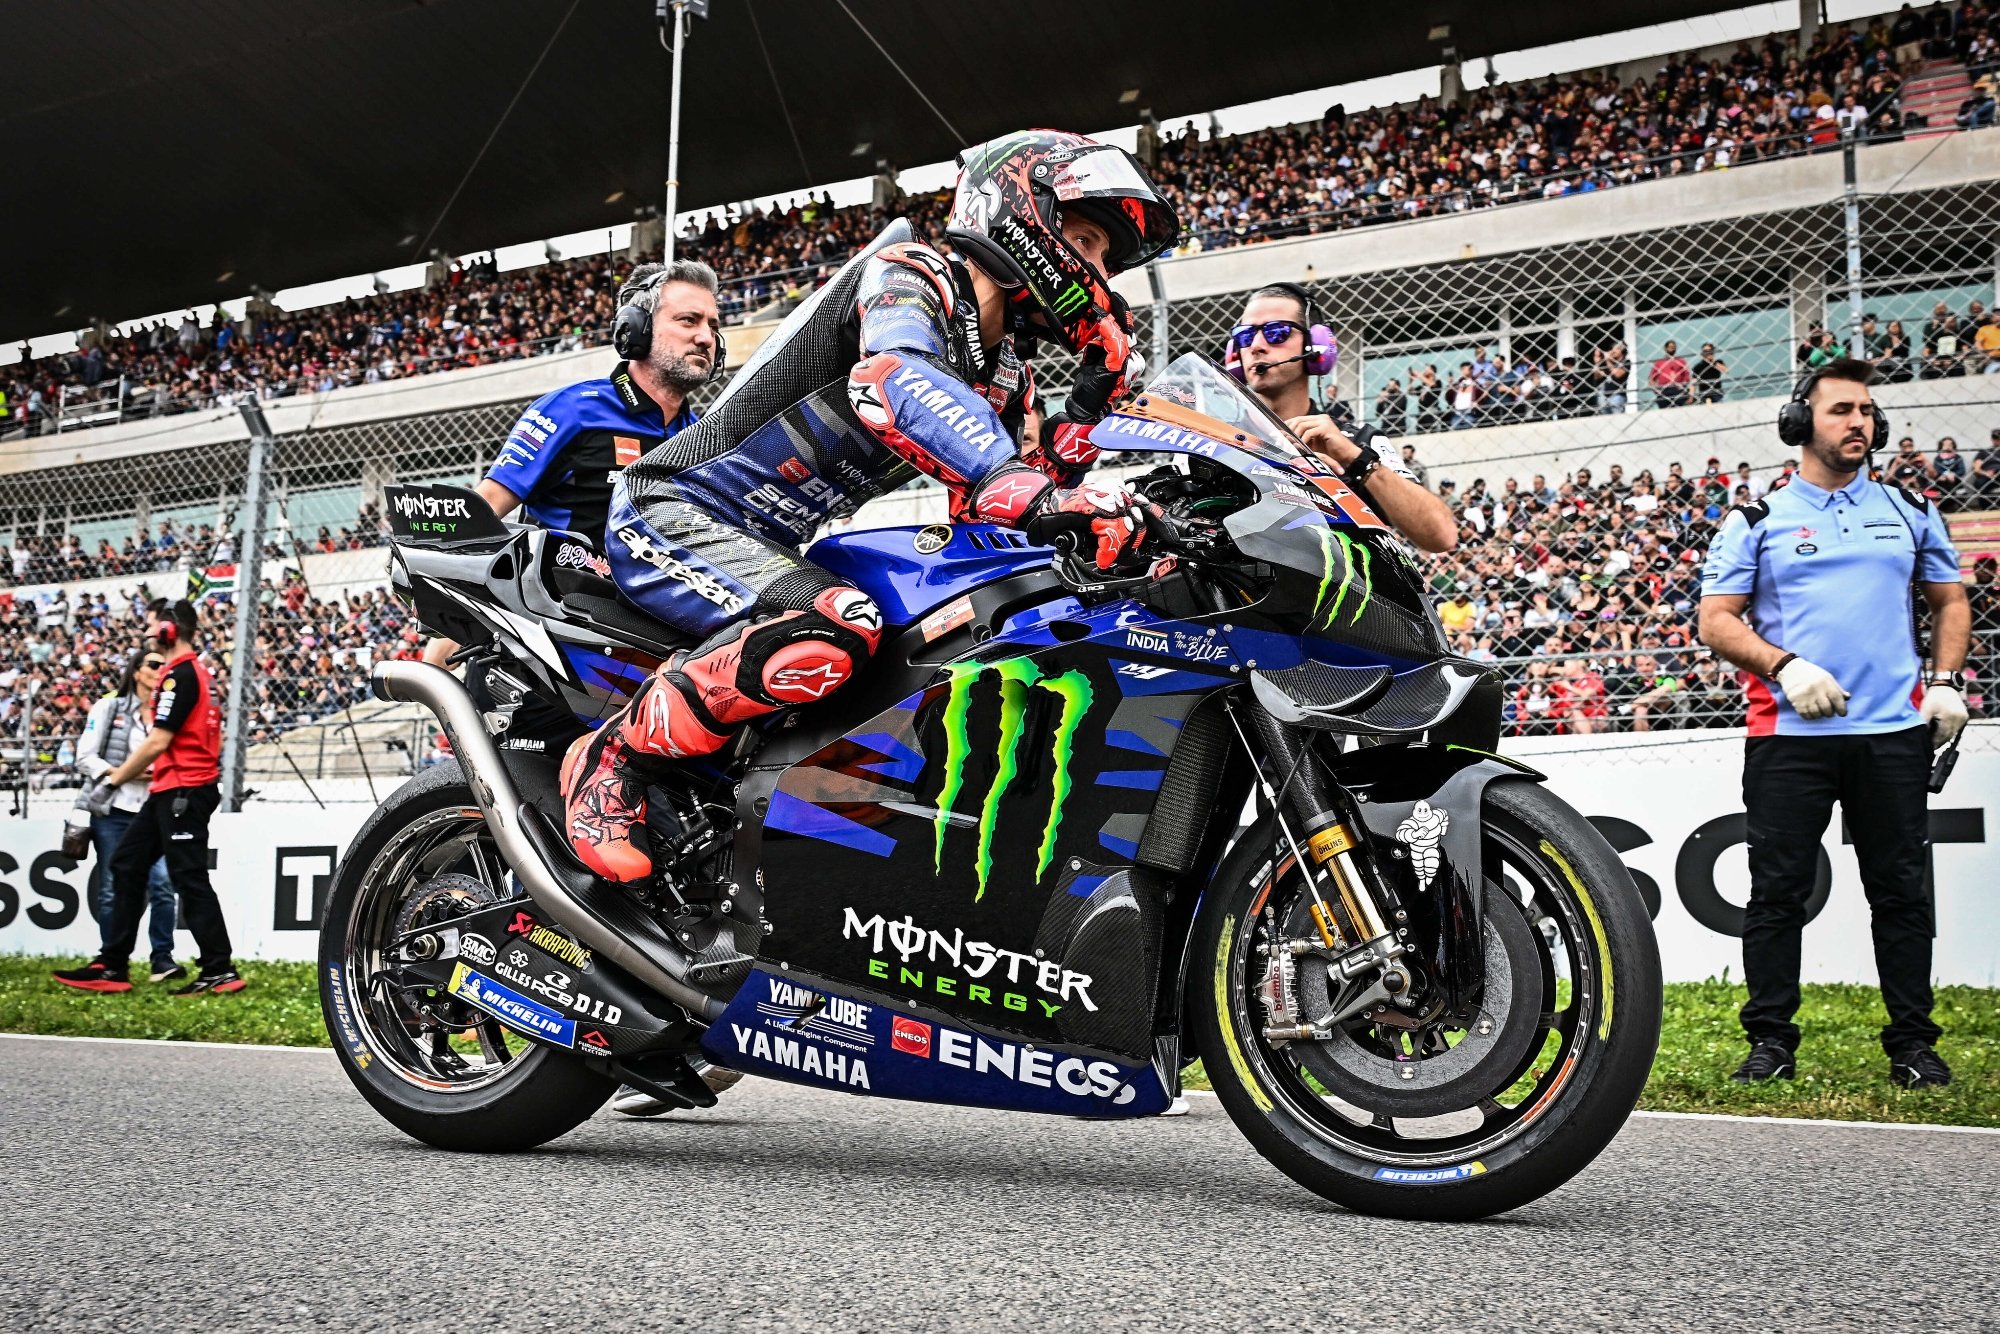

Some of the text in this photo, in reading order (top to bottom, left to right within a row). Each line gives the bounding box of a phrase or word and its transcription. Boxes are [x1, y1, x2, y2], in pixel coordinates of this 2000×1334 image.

[1002, 216, 1062, 289] MONSTER
[1003, 238, 1043, 285] ENERGY
[965, 311, 986, 371] YAMAHA
[893, 366, 1000, 453] YAMAHA
[1106, 415, 1220, 458] YAMAHA
[393, 493, 471, 519] MONSTER
[1273, 481, 1335, 510] YAMALUBE
[618, 527, 746, 616] alpinestars
[1126, 633, 1170, 653] INDIA
[1185, 643, 1230, 662] BLUE
[509, 738, 546, 750] YAMAHA
[462, 935, 495, 961] BMC
[842, 906, 1099, 1012] MONSTER
[494, 961, 531, 988] GILLES
[530, 979, 574, 1007] RCB
[868, 958, 1063, 1018] ENERGY
[1273, 965, 1282, 1011] brembo
[330, 967, 359, 1043] MICHELIN
[482, 989, 562, 1035] MICHELIN
[573, 992, 622, 1025] D.I.D
[731, 1023, 871, 1090] YAMAHA
[797, 1028, 822, 1042] Engine
[823, 1035, 868, 1053] Component
[894, 1028, 928, 1045] ENEOS
[939, 1027, 1136, 1106] ENEOS
[1380, 1170, 1458, 1181] MICHELIN
